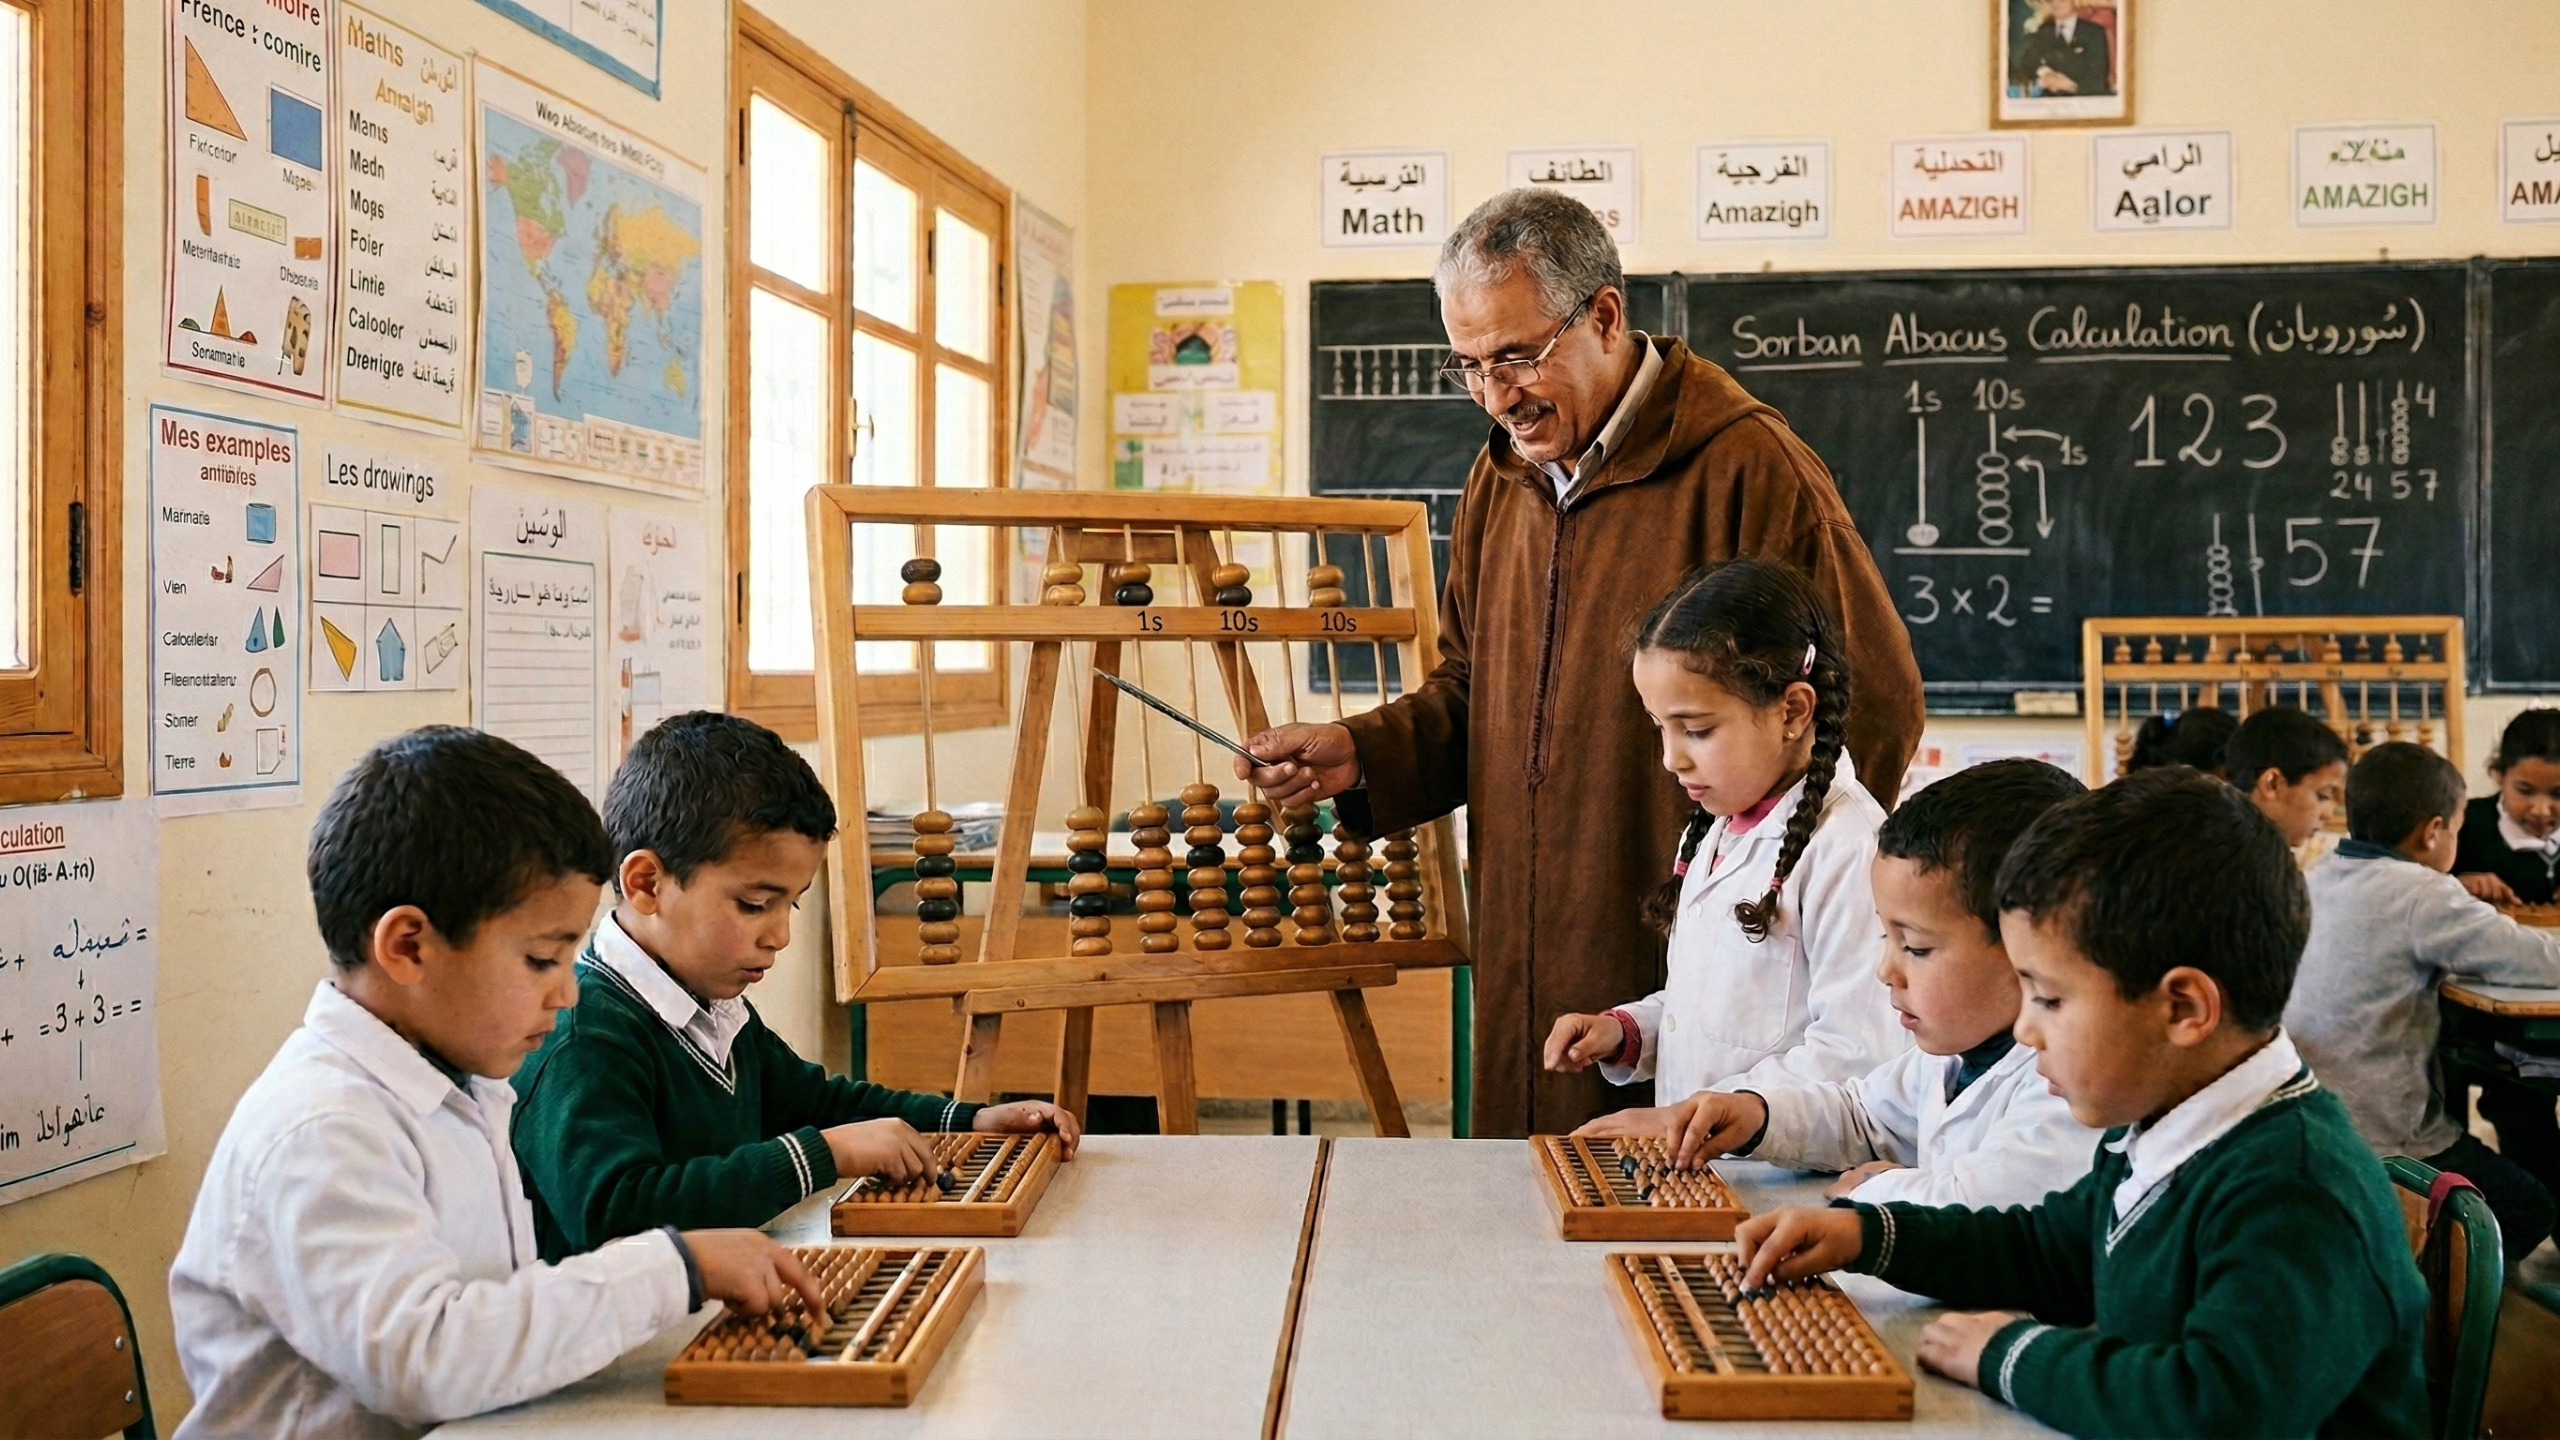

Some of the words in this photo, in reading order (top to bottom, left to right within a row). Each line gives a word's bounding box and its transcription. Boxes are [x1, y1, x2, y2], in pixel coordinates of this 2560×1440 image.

[348, 14, 404, 67] Maths
[1899, 195, 2018, 220] AMAZIGH
[2302, 182, 2428, 210] AMAZIGH
[1342, 207, 1424, 235] Math
[1706, 199, 1819, 228] Amazigh
[1731, 314, 1863, 360] Sorban
[1883, 311, 2009, 355] Abacus
[2028, 301, 2235, 352] Calculation
[1904, 378, 1944, 413] 1s
[1971, 377, 2027, 412] 10s
[2415, 381, 2437, 418] 4
[161, 418, 201, 450] Mes
[205, 432, 291, 465] examples
[2059, 435, 2089, 466] 1s
[327, 453, 359, 486] Les
[1136, 609, 1163, 632] 1s
[1219, 609, 1259, 632] 10s
[1320, 611, 1357, 632] 10s
